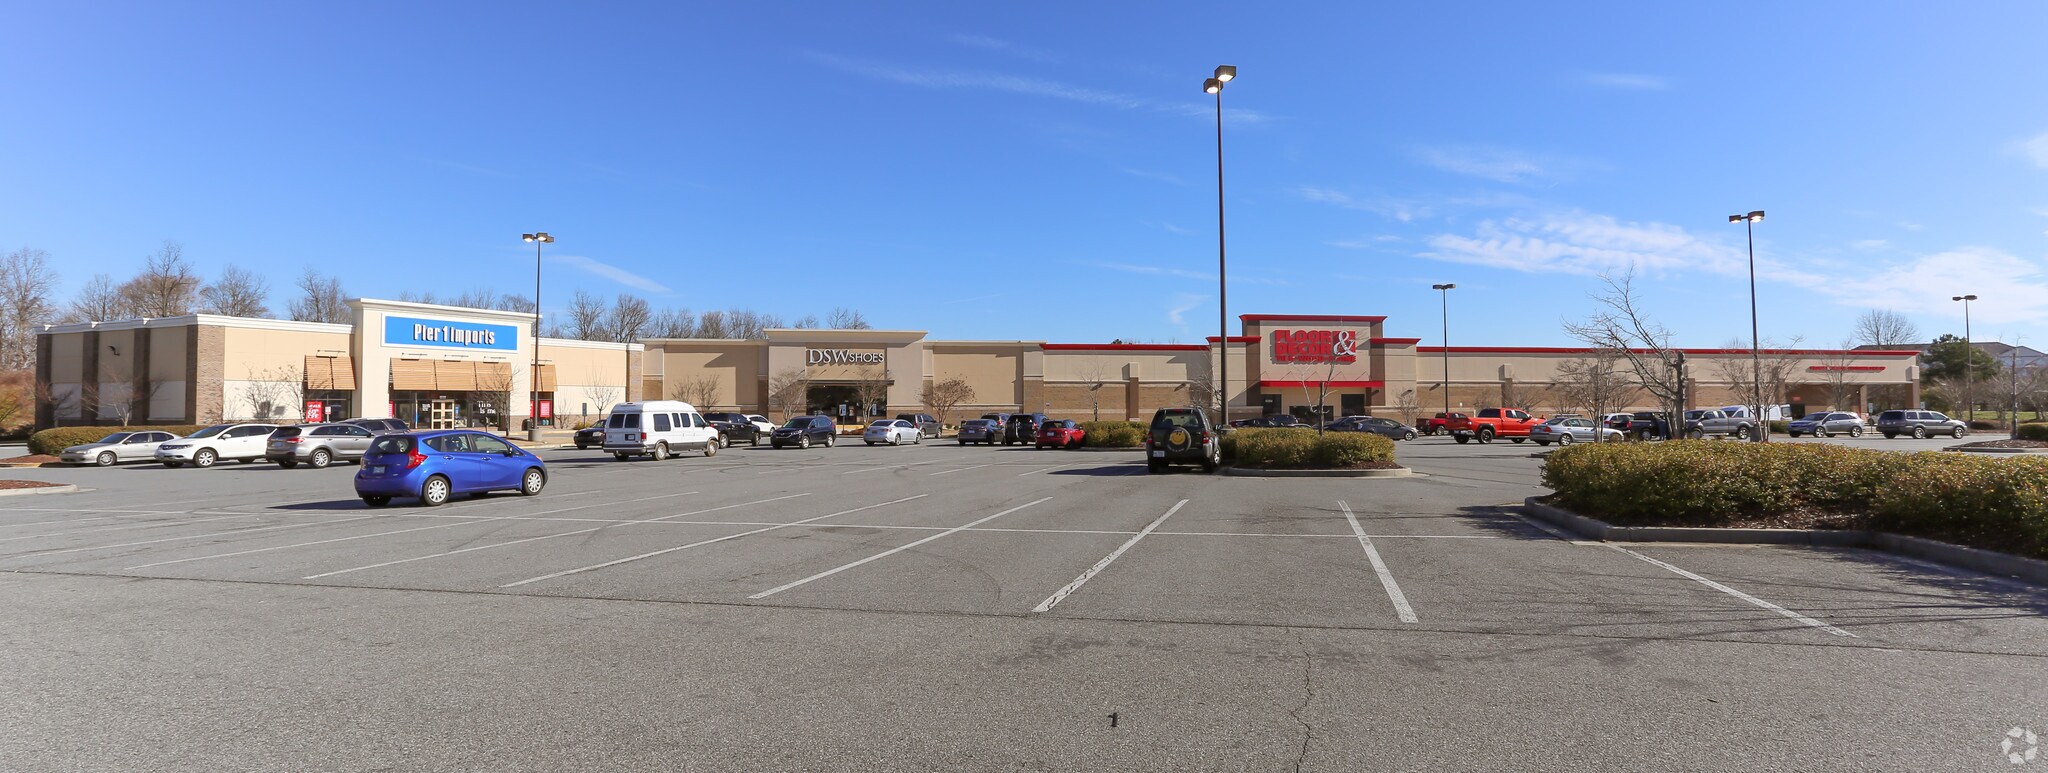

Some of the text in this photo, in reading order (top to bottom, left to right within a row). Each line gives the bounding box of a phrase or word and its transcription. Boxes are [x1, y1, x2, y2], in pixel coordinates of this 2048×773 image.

[414, 323, 495, 346] Pier 1 Imports
[1275, 330, 1332, 342] FLOOR
[1275, 342, 1332, 355] DECOR
